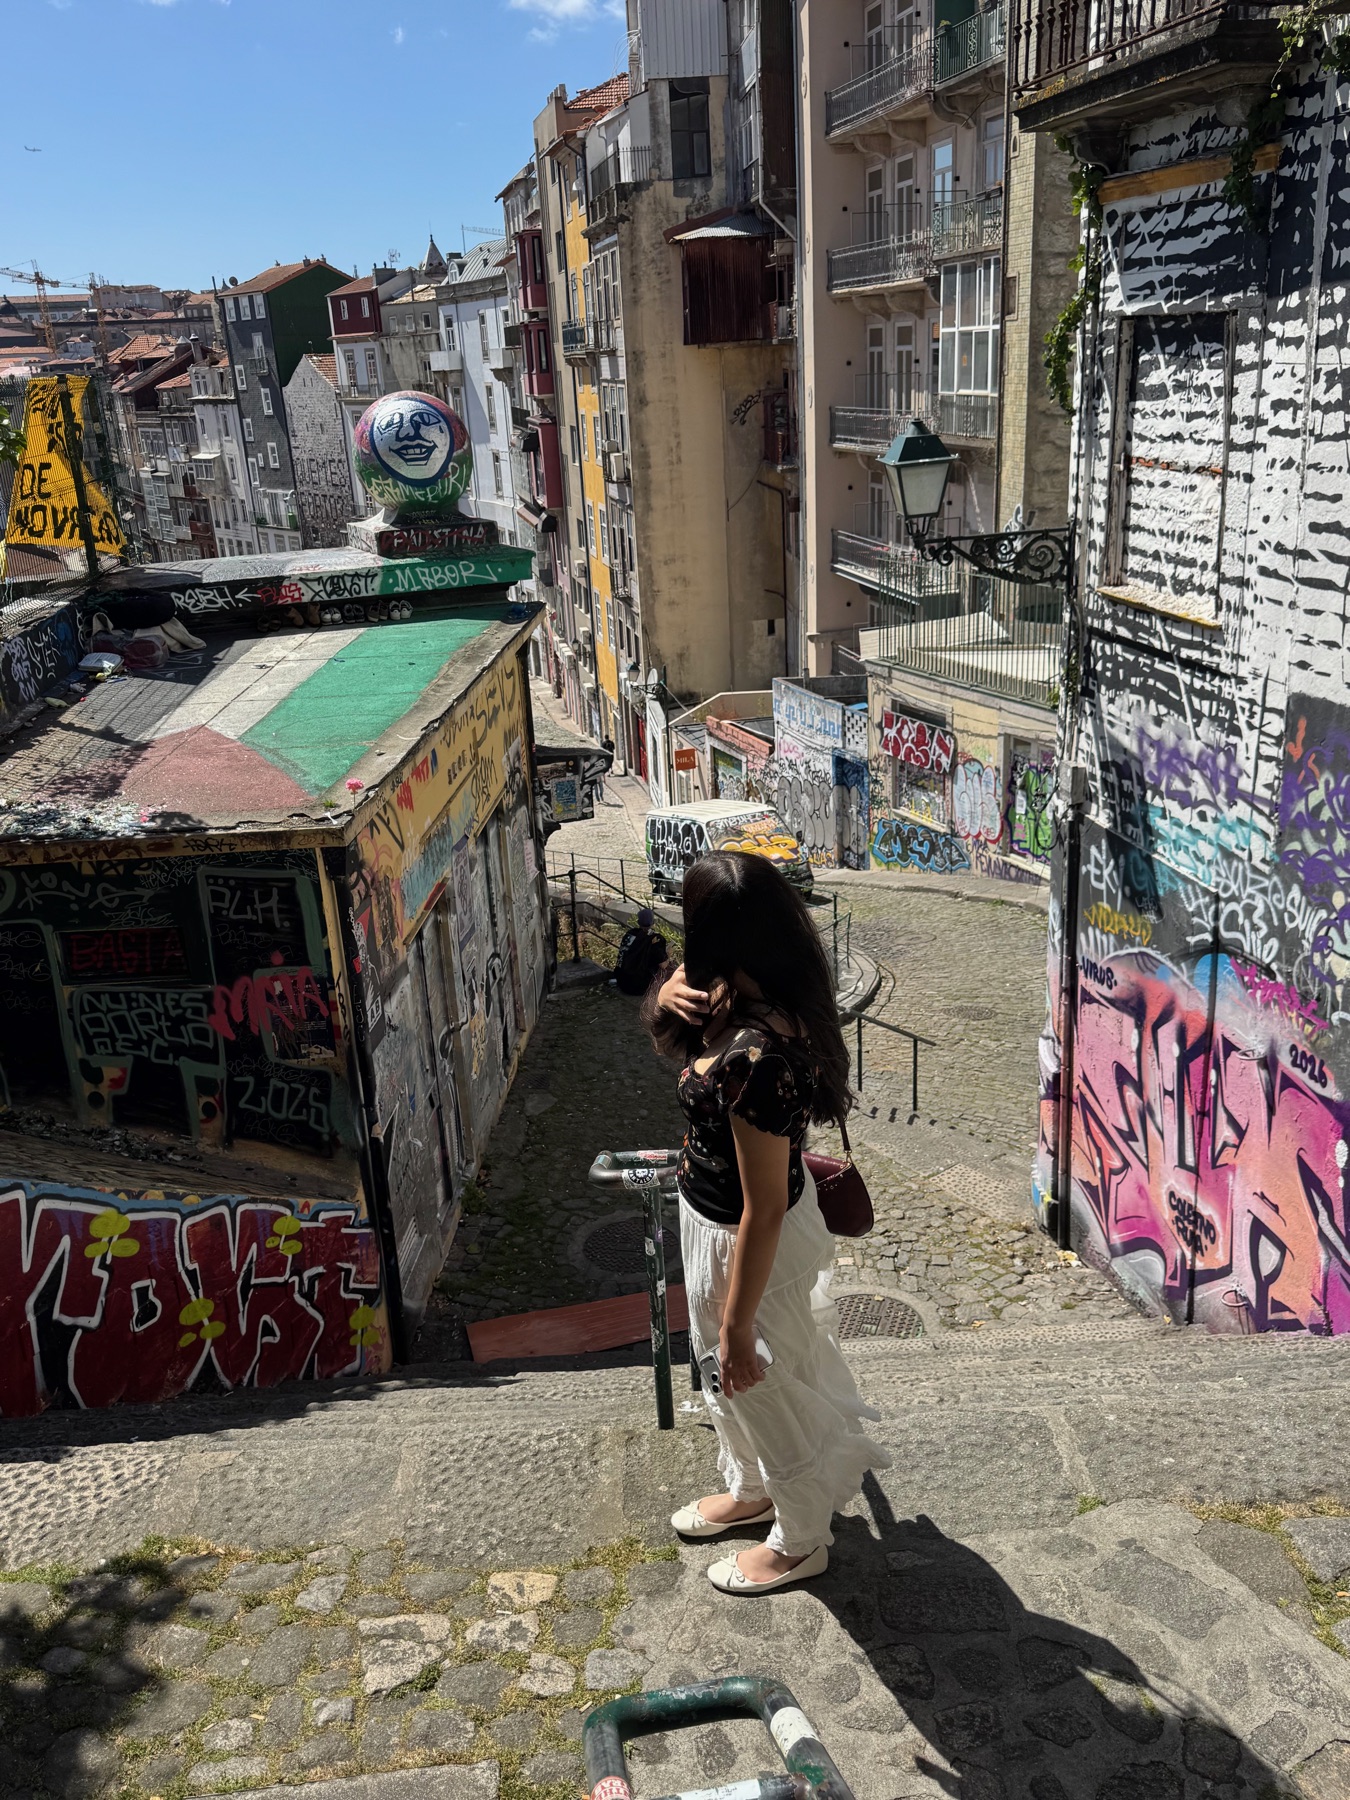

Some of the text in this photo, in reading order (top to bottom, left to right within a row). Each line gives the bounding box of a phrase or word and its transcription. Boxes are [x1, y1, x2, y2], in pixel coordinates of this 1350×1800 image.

[19, 462, 52, 500] DE
[69, 930, 184, 974] BASTA
[1289, 1044, 1328, 1089] 2026
